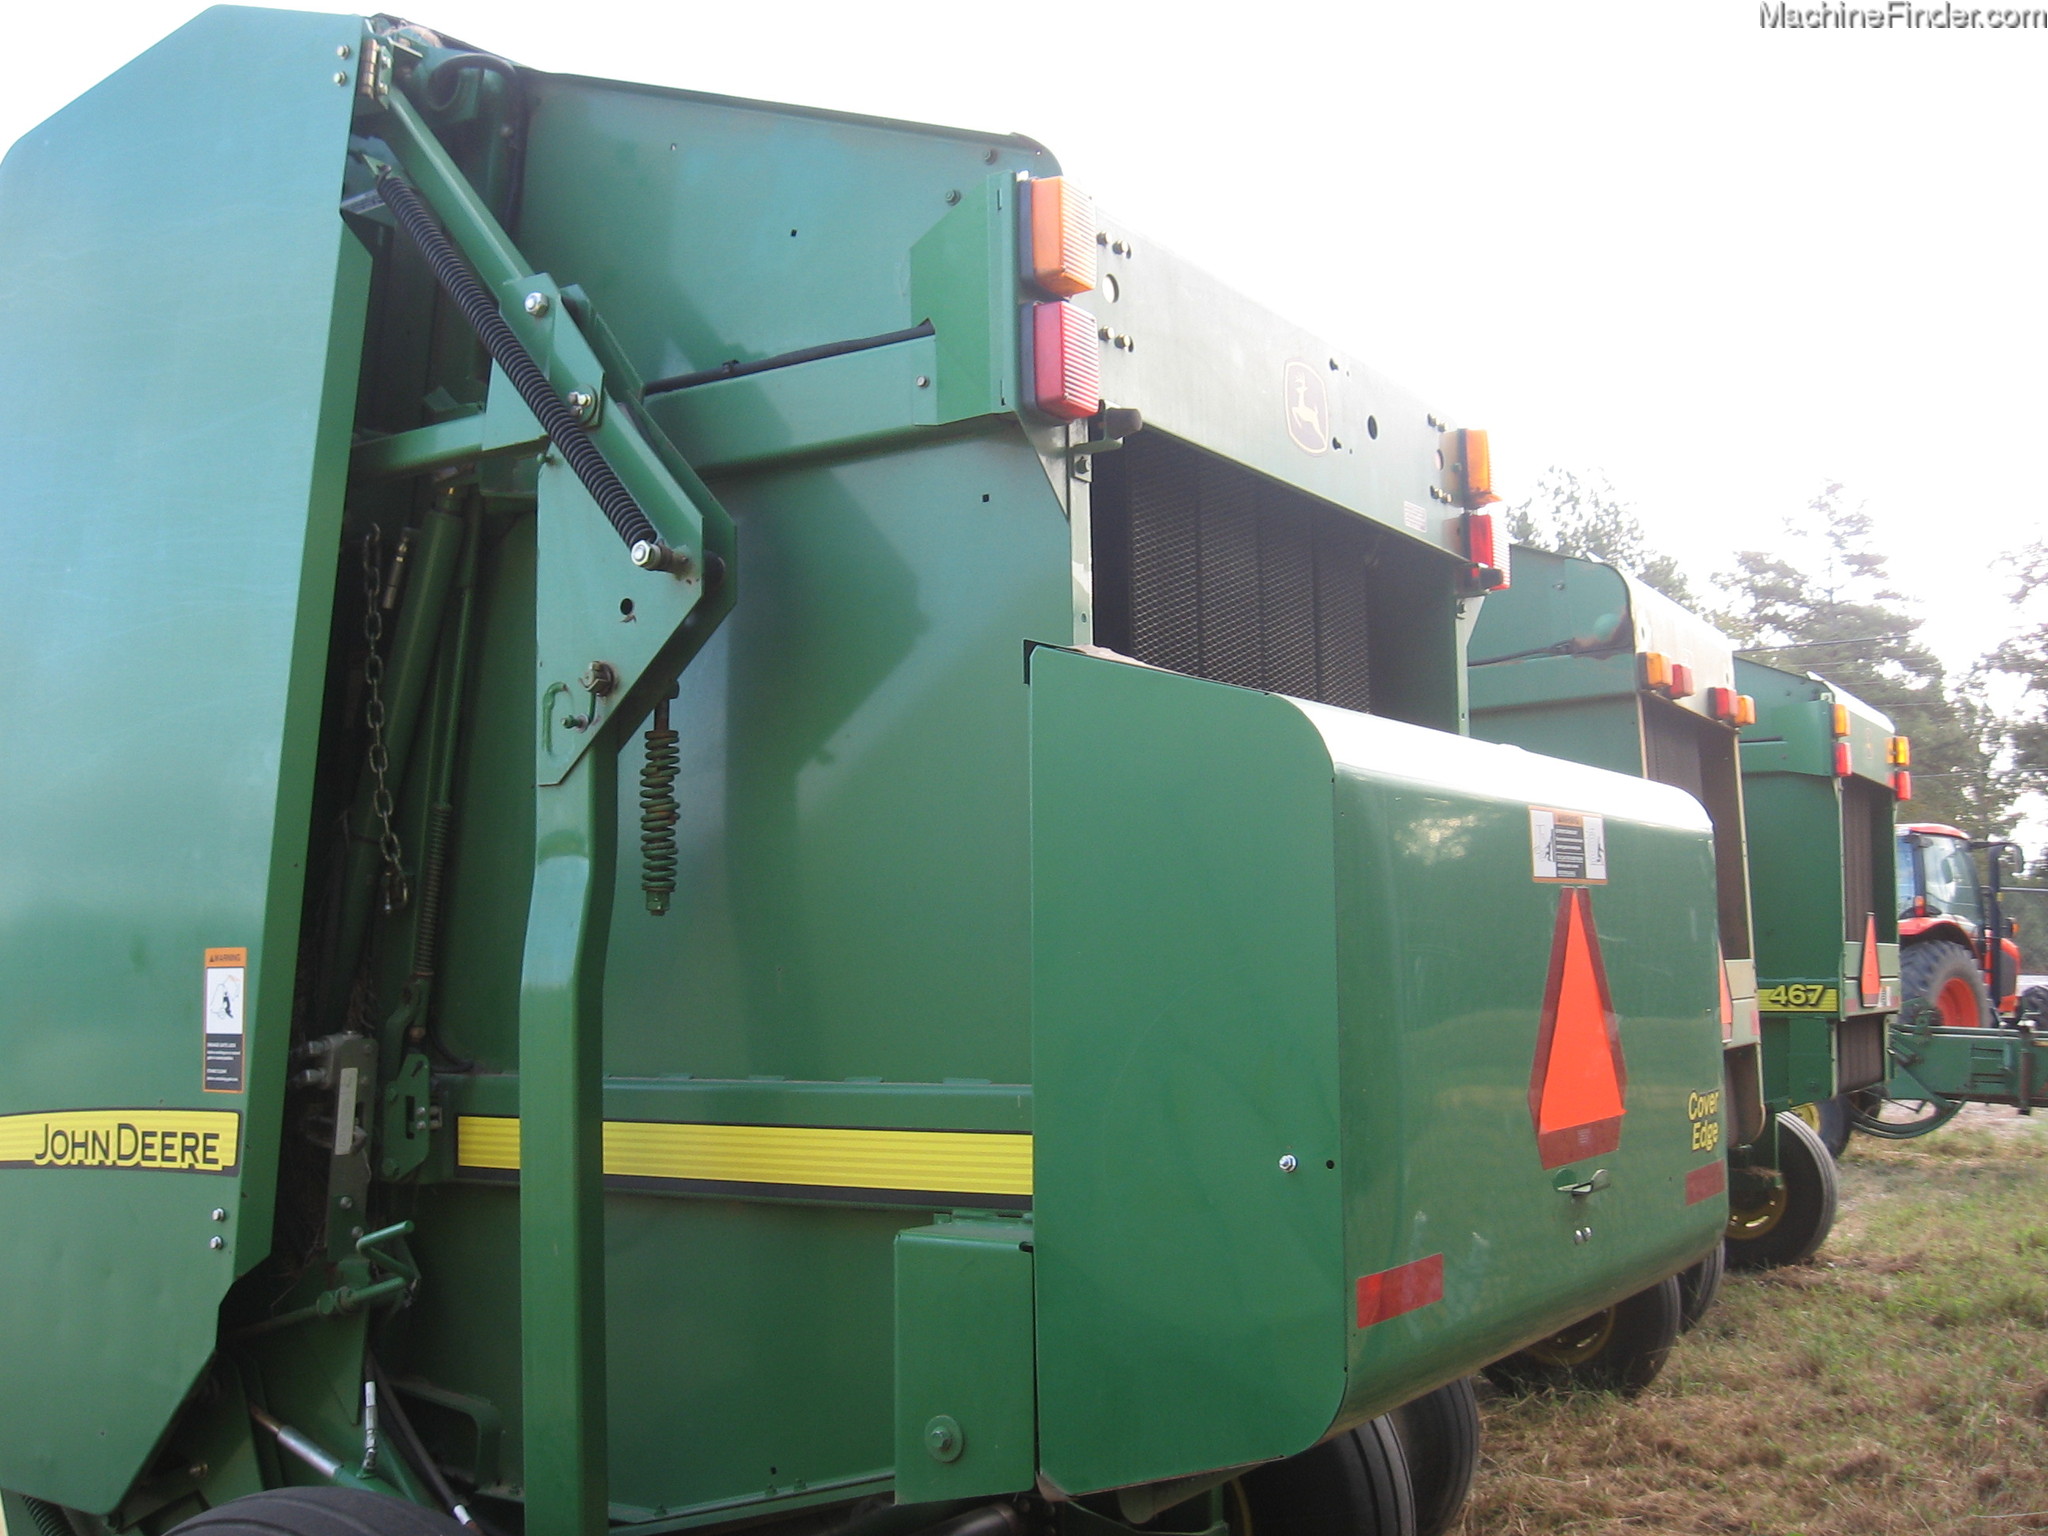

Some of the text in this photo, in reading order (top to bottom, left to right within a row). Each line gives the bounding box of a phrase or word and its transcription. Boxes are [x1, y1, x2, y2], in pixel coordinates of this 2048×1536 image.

[1769, 983, 1824, 1006] 467
[1688, 1090, 1719, 1121] Cover
[34, 1122, 221, 1165] JOHN DEERE
[1691, 1119, 1719, 1152] Edge
